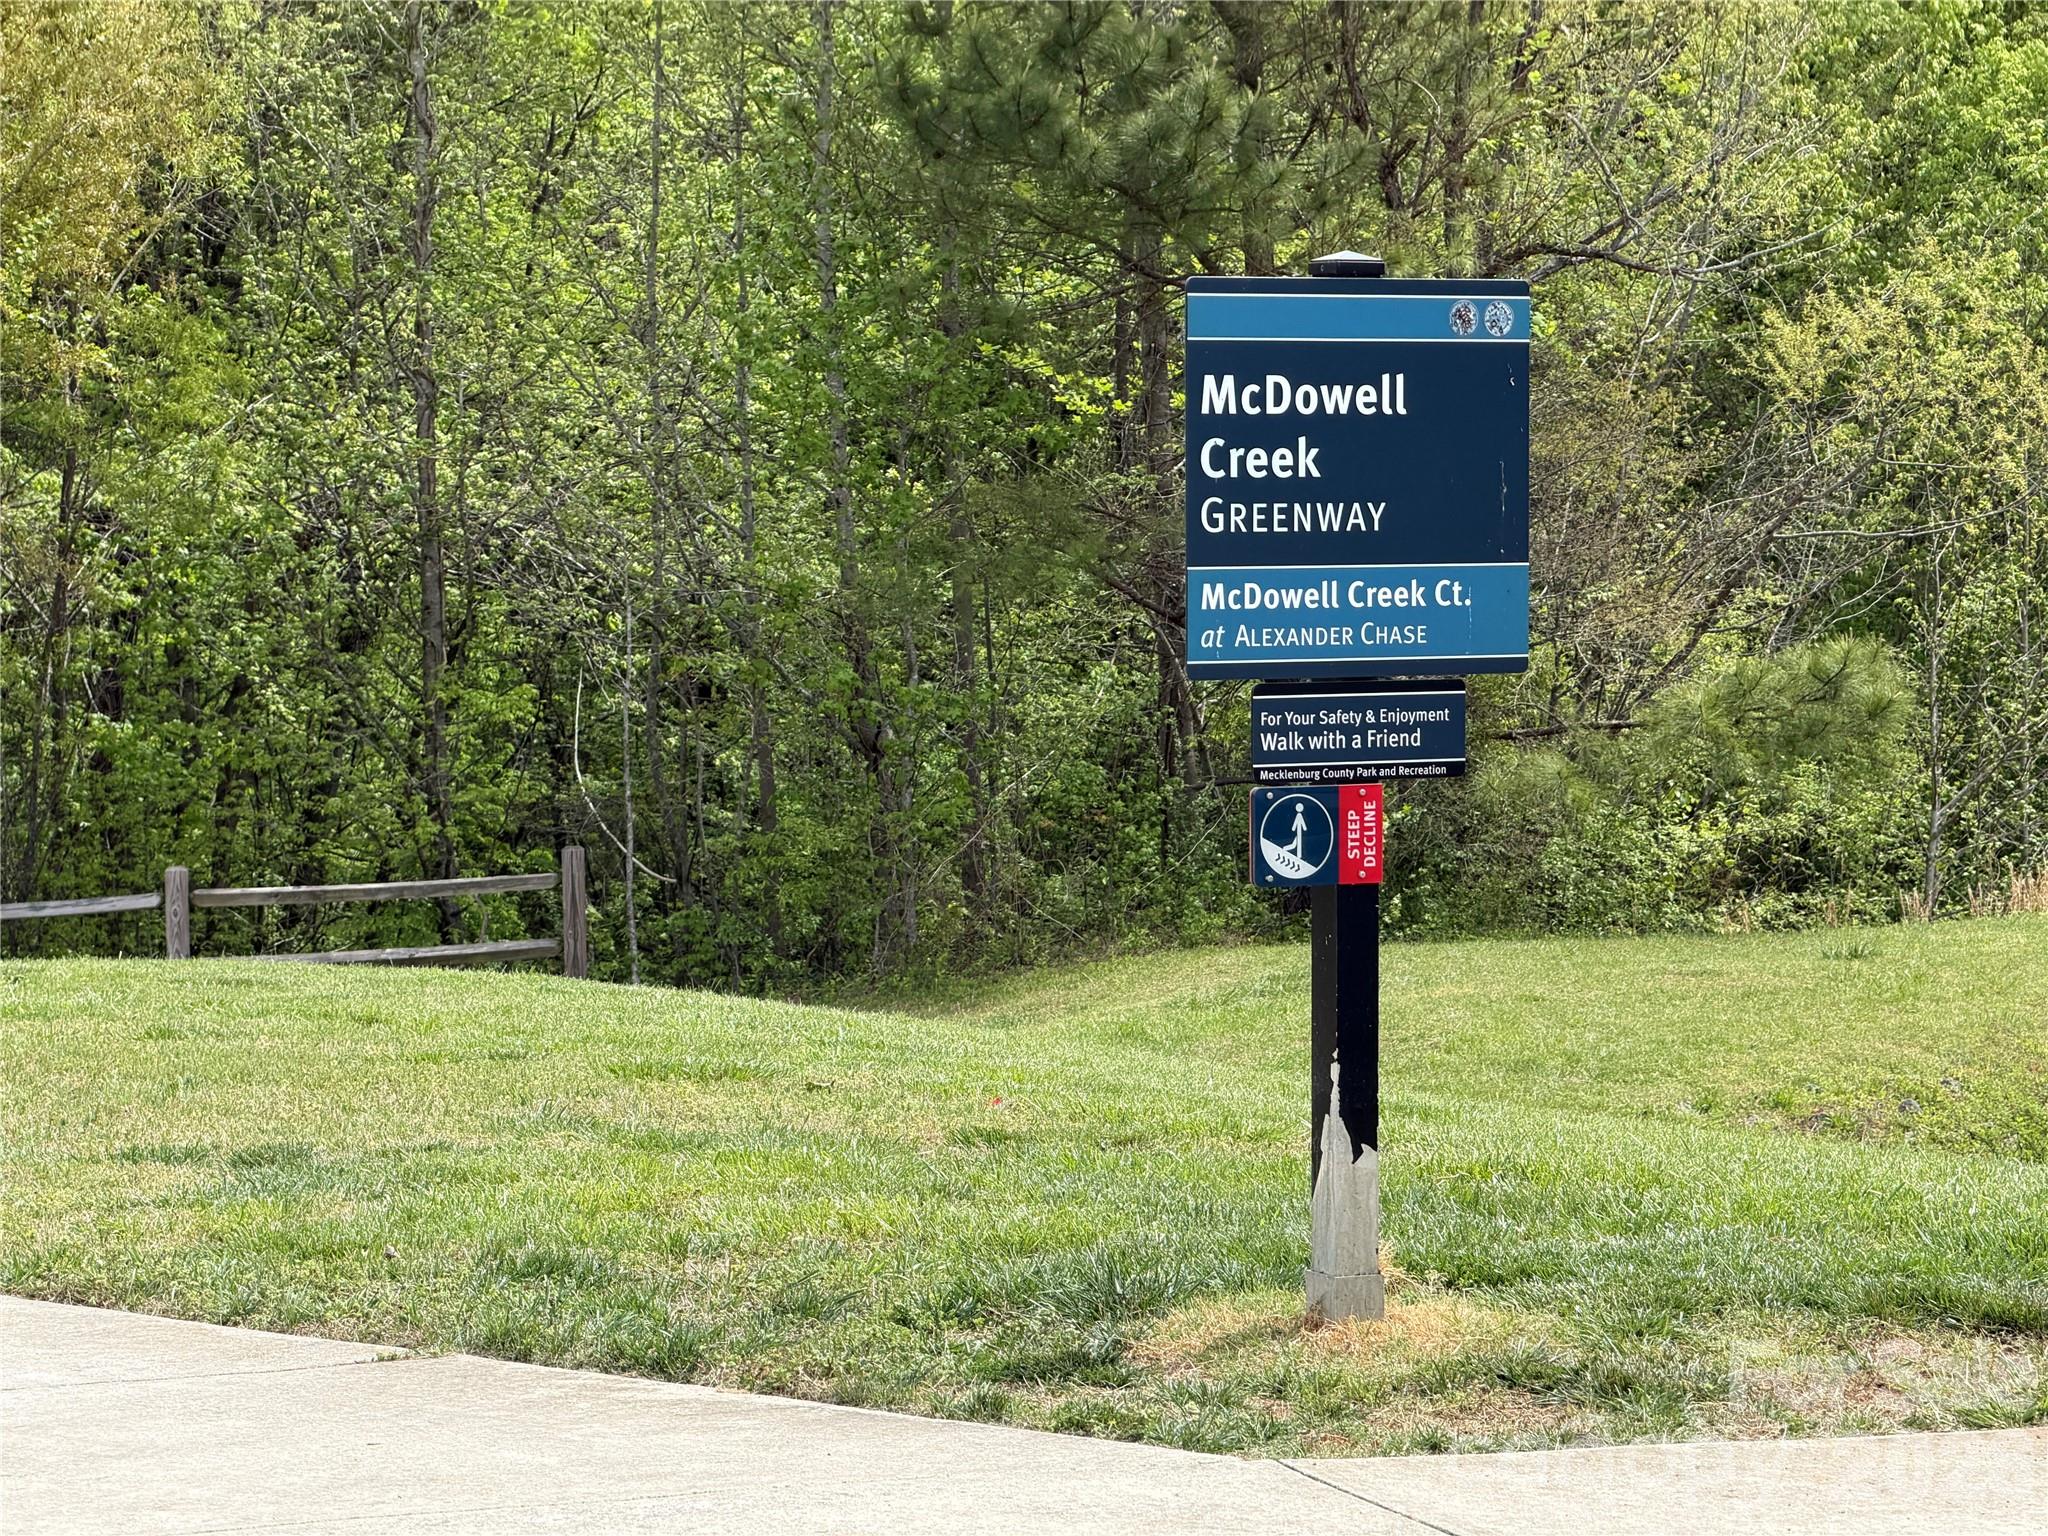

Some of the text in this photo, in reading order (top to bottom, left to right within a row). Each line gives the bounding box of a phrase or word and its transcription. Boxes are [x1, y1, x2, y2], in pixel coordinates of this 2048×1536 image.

[1201, 373, 1407, 415] McDowell
[1200, 436, 1321, 479] Creek
[1201, 496, 1386, 533] GREENWAY
[1202, 579, 1471, 610] McDowell Creek Ct.
[1201, 622, 1427, 648] at ALEXANDER CHASE
[1260, 708, 1449, 726] For Your Safety & Enjoyment
[1260, 728, 1421, 751] Walk with a Friend
[1260, 765, 1447, 781] Mecklenburg County Park and Recreation
[1347, 810, 1360, 859] STEEP
[1363, 800, 1376, 867] DECLINE
